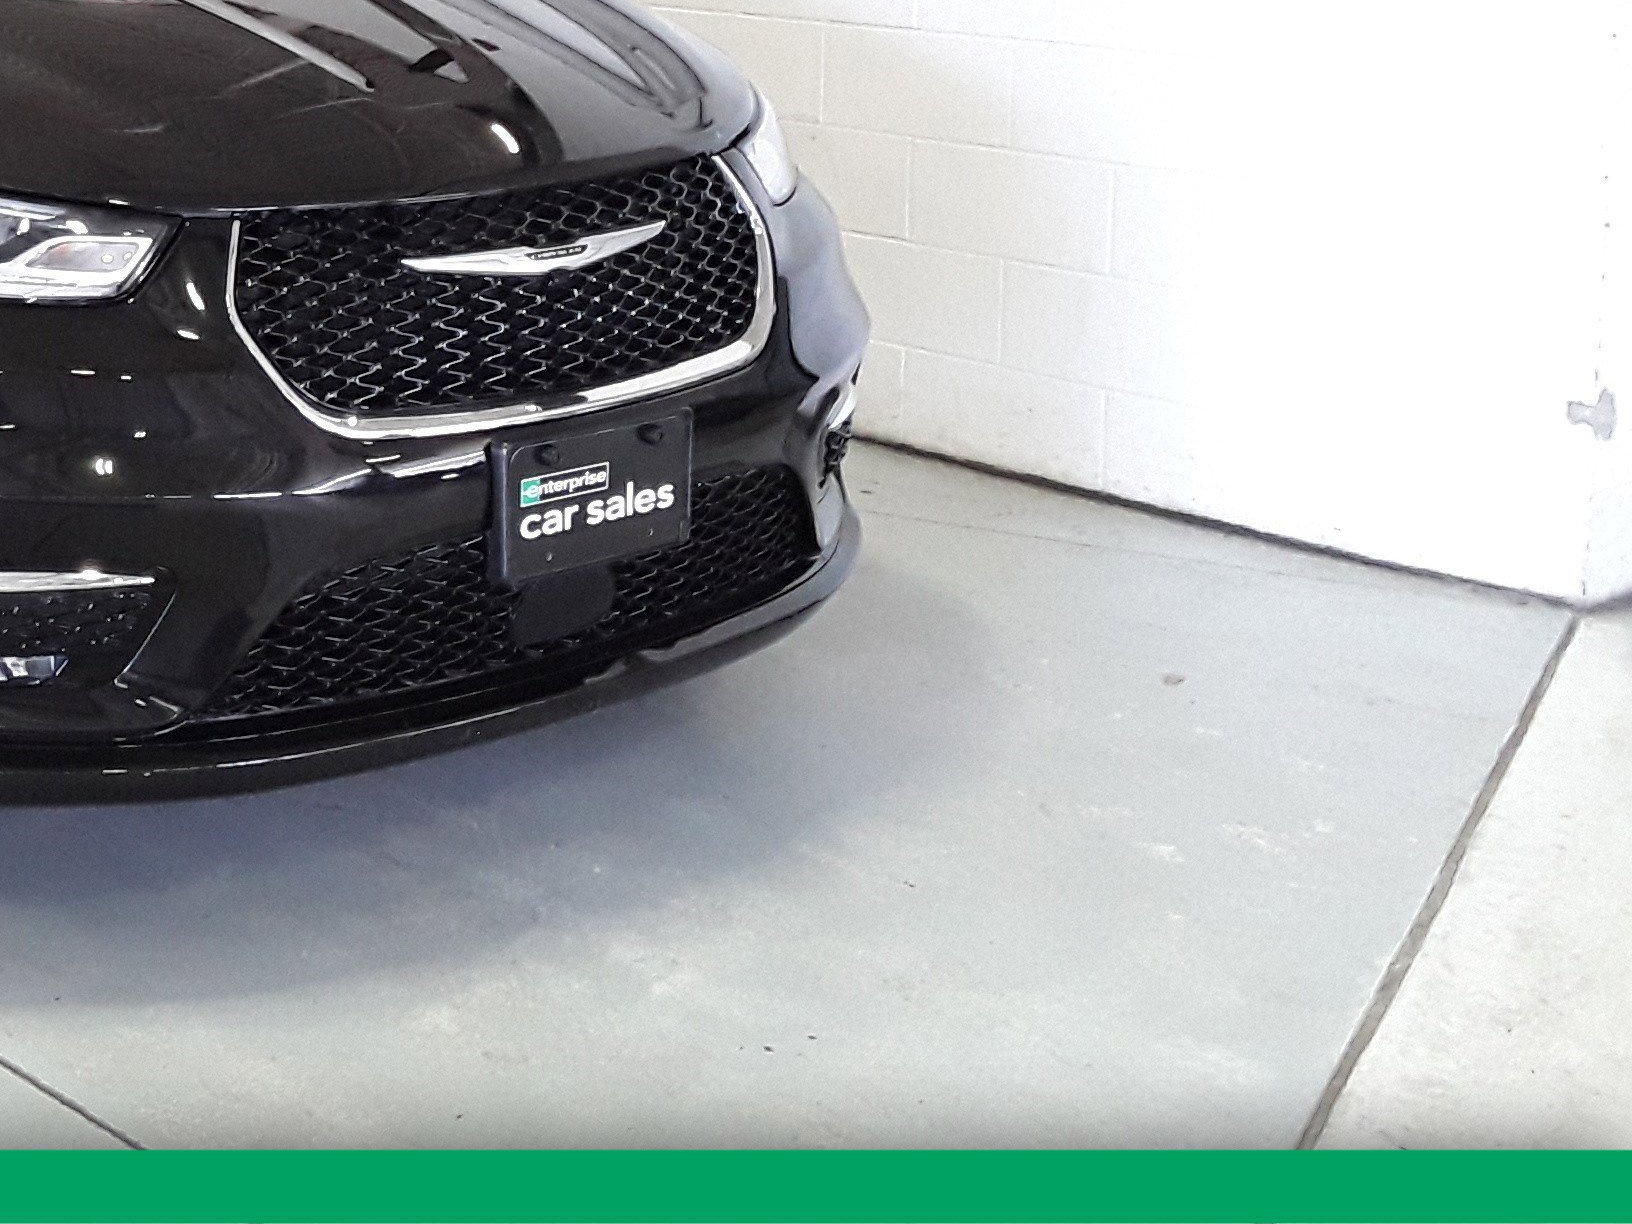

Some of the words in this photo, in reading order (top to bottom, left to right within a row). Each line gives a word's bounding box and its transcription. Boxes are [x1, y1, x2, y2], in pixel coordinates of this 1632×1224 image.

[525, 470, 607, 499] enterprise
[519, 504, 579, 539] car
[586, 480, 675, 526] sales
